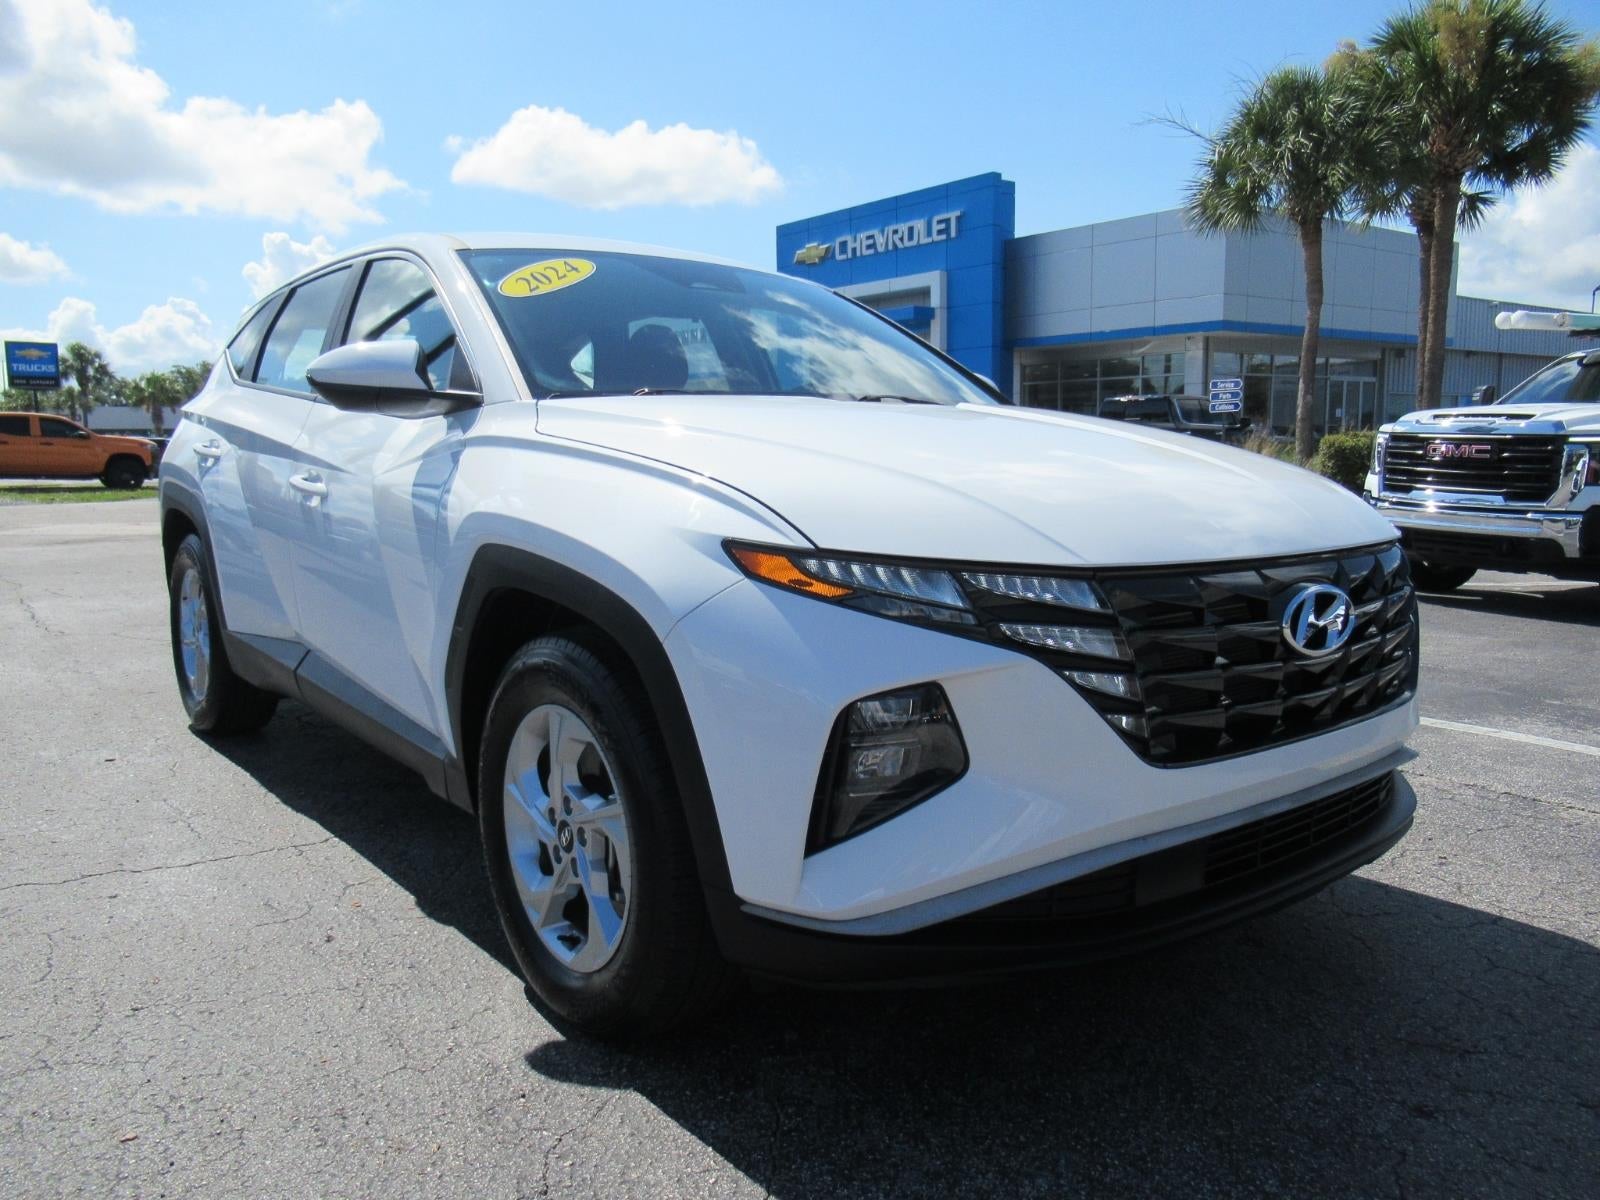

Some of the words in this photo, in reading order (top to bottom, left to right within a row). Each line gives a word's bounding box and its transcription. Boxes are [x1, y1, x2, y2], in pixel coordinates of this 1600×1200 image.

[835, 210, 962, 261] CHEVROLET
[516, 261, 581, 293] 2024
[12, 363, 56, 372] TRUCKS
[1427, 443, 1491, 458] GMC
